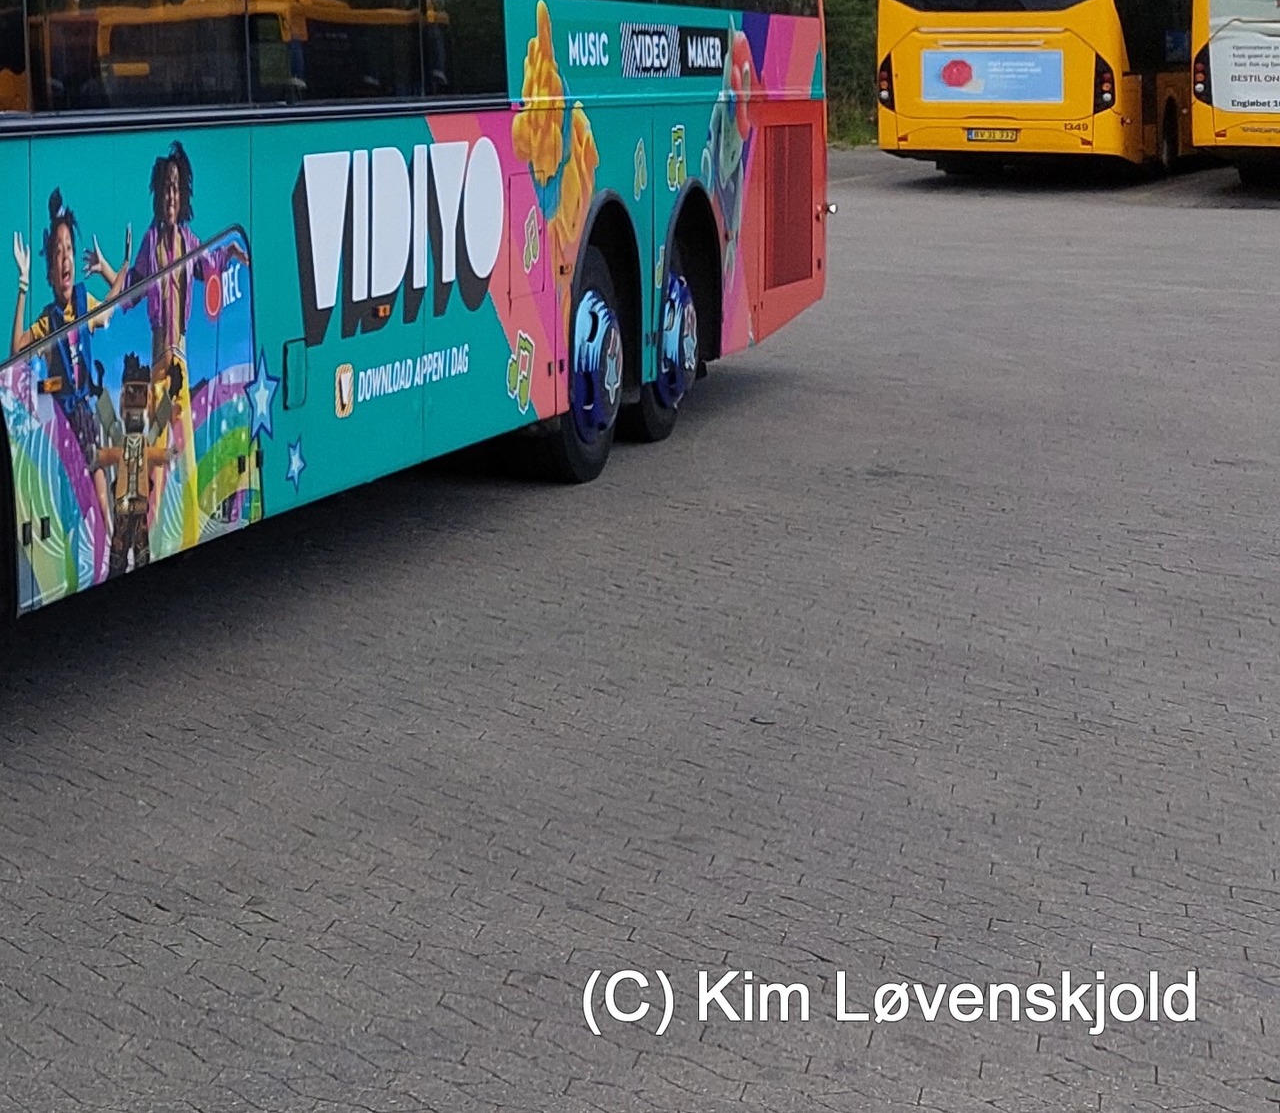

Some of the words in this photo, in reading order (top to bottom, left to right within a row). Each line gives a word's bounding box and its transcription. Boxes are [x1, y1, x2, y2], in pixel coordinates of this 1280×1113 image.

[568, 31, 609, 67] MUSIC
[632, 34, 669, 68] VIDEO
[687, 35, 723, 69] MAKER
[302, 136, 504, 311] VIDIYO
[222, 263, 242, 307] REC
[357, 358, 413, 403] DOWNLOAD
[413, 350, 445, 387] APPEN
[450, 343, 469, 377] DAG
